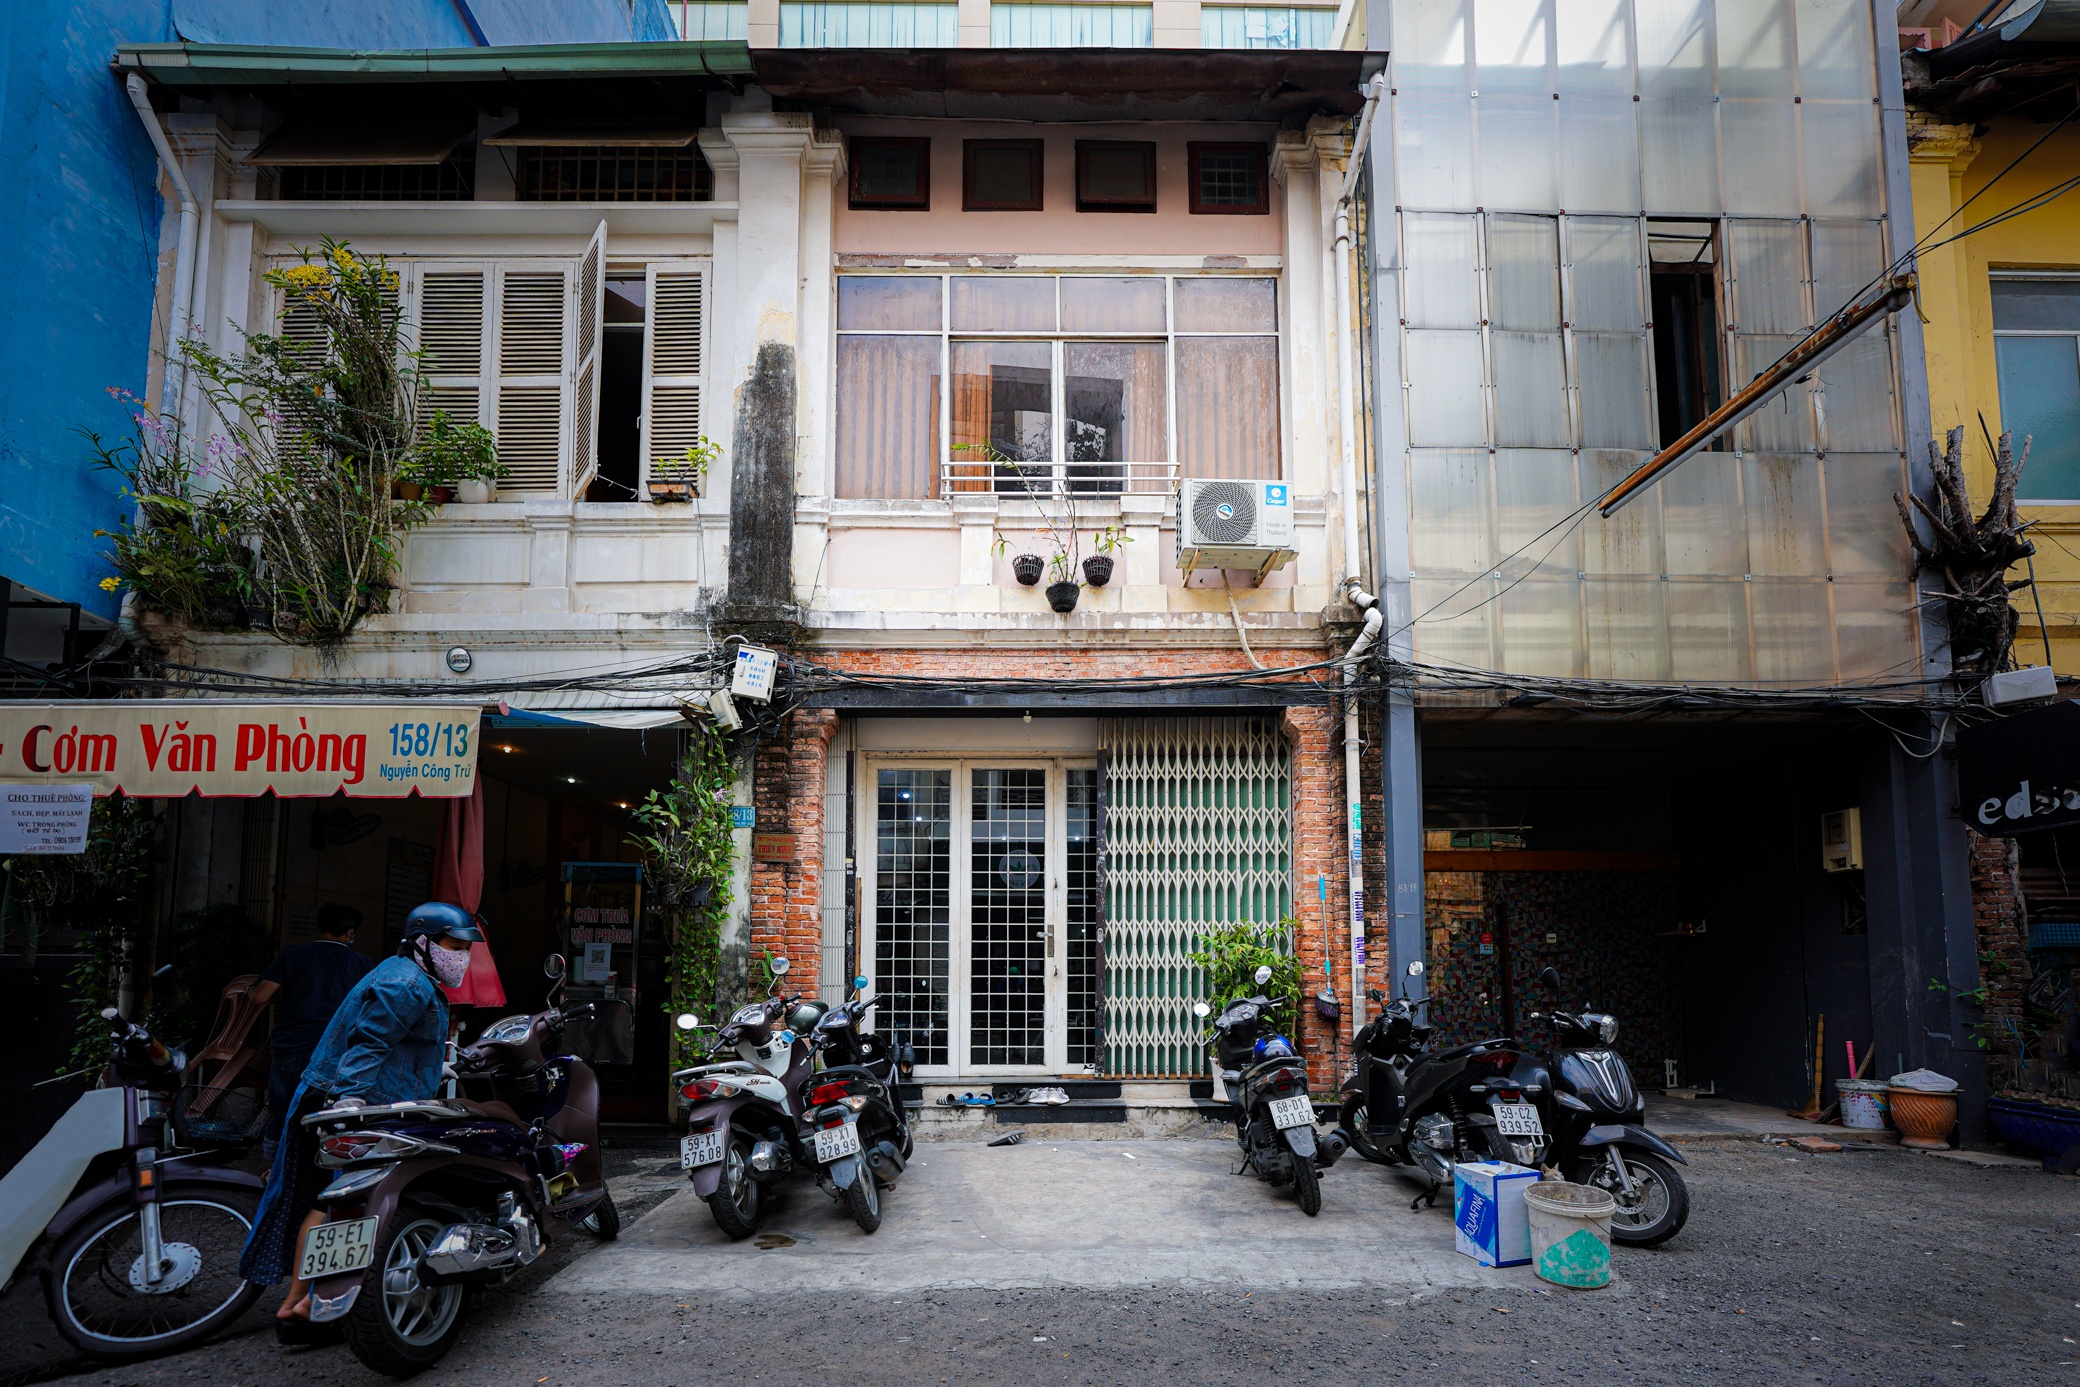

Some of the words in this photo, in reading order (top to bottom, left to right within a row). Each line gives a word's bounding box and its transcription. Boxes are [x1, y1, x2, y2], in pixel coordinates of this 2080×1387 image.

[389, 722, 469, 757] 158/13
[22, 724, 118, 773] Cơm
[140, 720, 217, 772] Văn
[234, 716, 367, 784] Phòng
[379, 760, 418, 781] Nguyễn
[421, 763, 451, 781] Công
[31, 793, 56, 802] THUÊ
[574, 906, 598, 923] CƠM
[600, 907, 629, 923] TRƯA
[571, 925, 593, 942] VĂN
[595, 925, 632, 944] PHÒNG
[1276, 1110, 1312, 1126] 331.62
[1500, 1107, 1532, 1119] 59-C2
[821, 1127, 849, 1145] 59-X1
[1500, 1120, 1540, 1133] 939.52
[688, 1133, 715, 1151] 59-X1
[820, 1138, 857, 1159] 328.99
[684, 1146, 721, 1166] 576.08
[1464, 1193, 1486, 1240] AQUAFINA
[315, 1222, 364, 1249] 59-E1
[304, 1243, 369, 1275] 394.67
